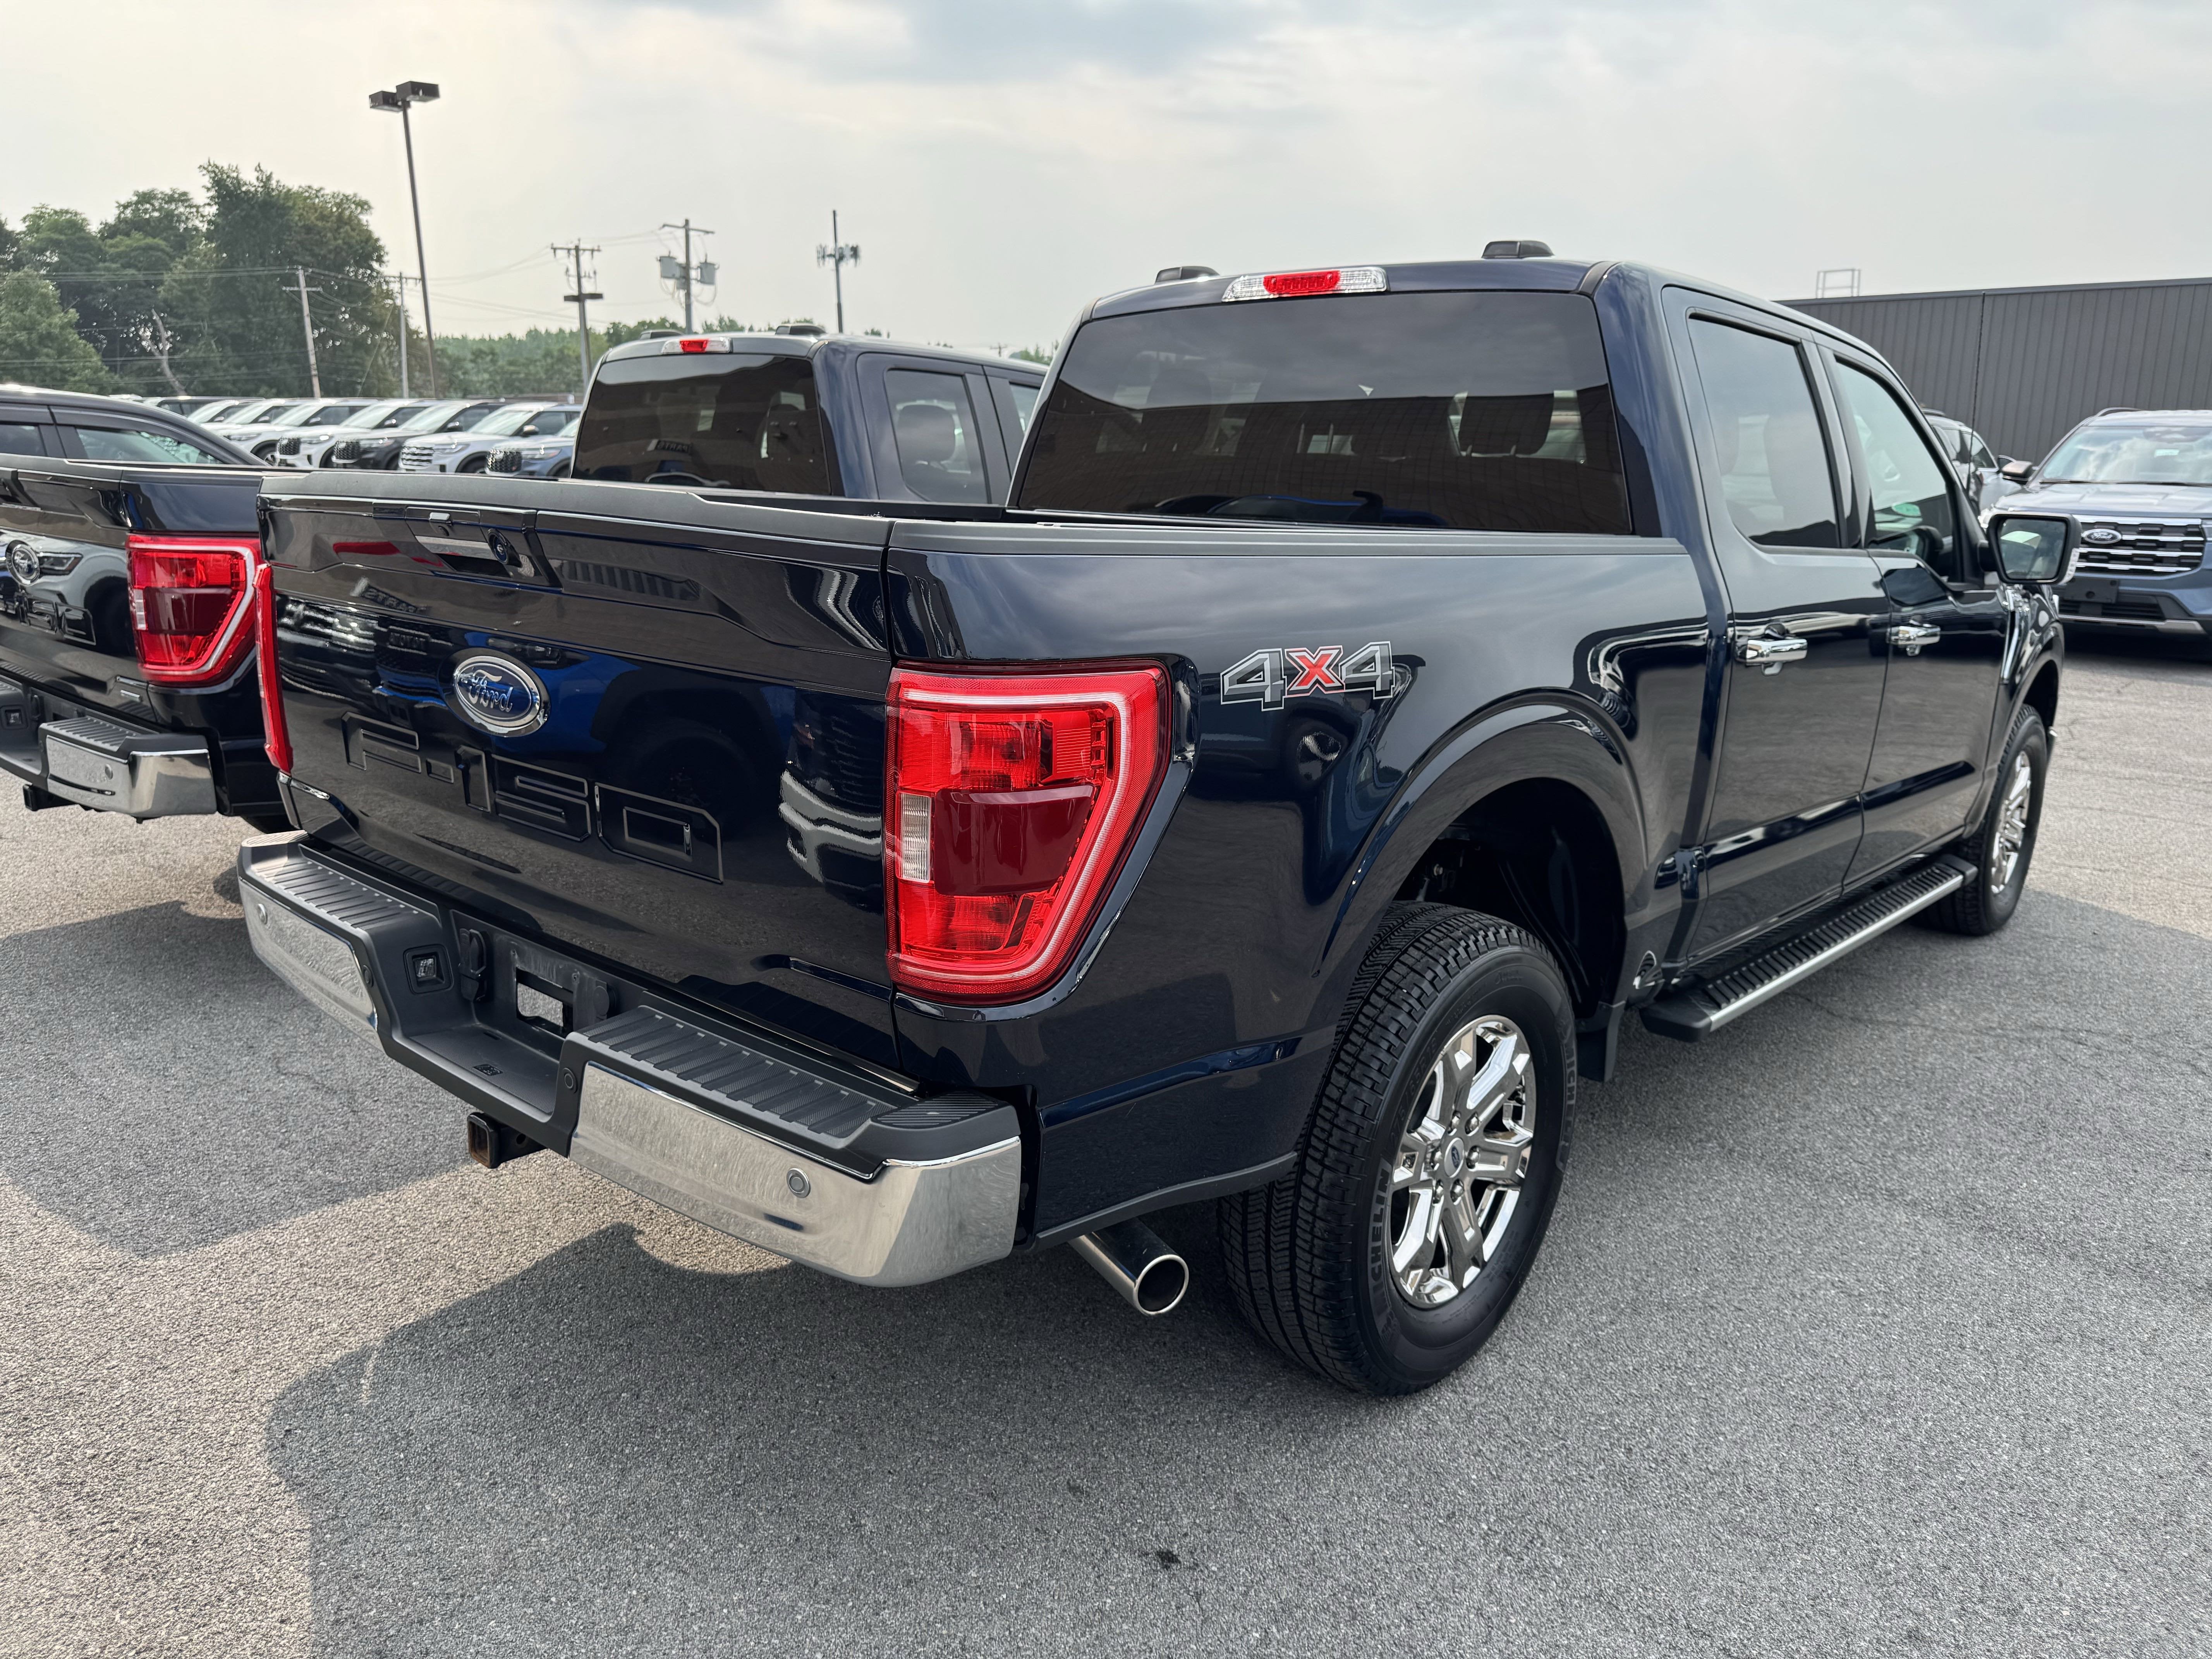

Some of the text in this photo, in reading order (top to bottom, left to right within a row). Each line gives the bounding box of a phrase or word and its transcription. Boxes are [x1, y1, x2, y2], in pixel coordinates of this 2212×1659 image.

[468, 669, 513, 713] Ford
[341, 711, 723, 884] F-150
[1370, 1167, 1389, 1317] MICHELIN
